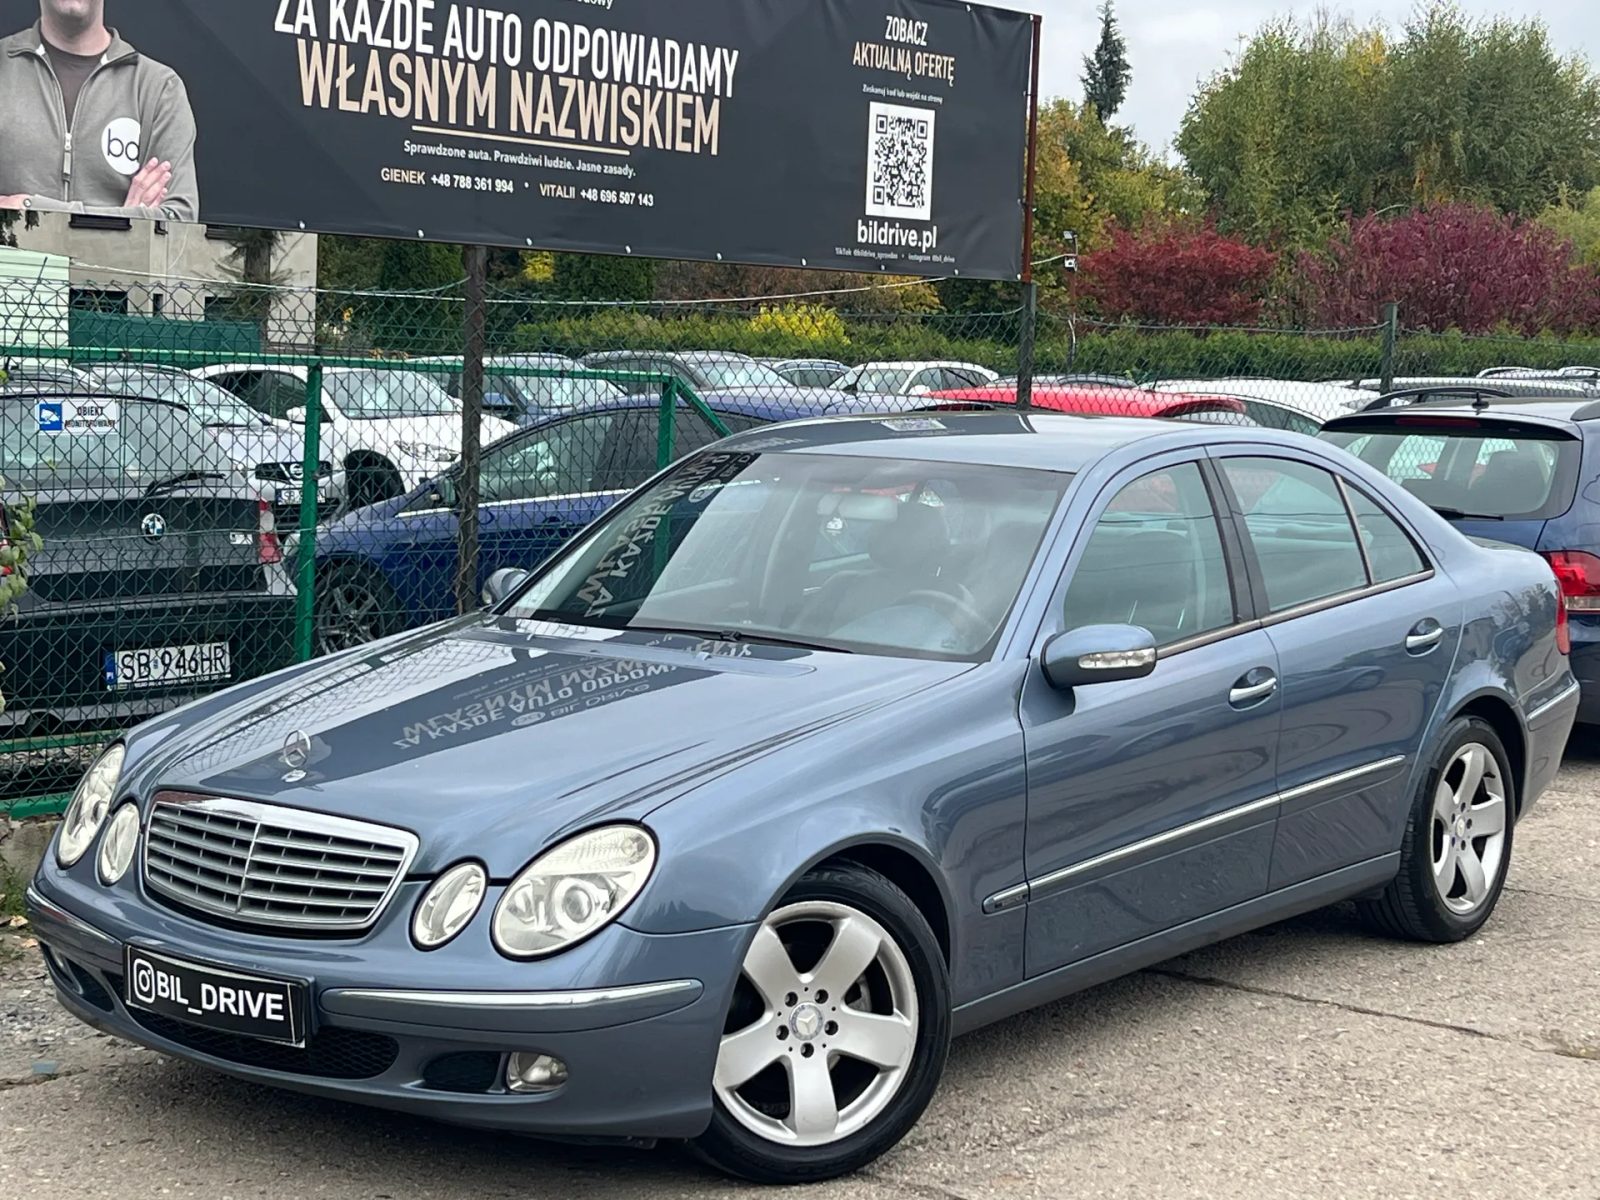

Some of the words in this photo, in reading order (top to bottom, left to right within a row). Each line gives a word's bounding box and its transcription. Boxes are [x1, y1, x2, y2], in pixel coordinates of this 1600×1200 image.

[885, 15, 928, 46] ZOBACZ
[442, 4, 522, 67] AUTO
[532, 18, 739, 98] ODPOWIADAMY
[853, 41, 912, 80] AKTUALNĄ
[914, 51, 955, 87] OFERTĘ
[297, 38, 497, 129] WŁASNYM
[510, 69, 720, 156] NAZWISKIEM
[404, 140, 466, 158] Sprawdzone
[468, 149, 492, 161] auta.
[494, 150, 542, 166] Prawdziwi
[544, 155, 575, 170] ludzie.
[576, 160, 602, 173] Jasne
[603, 164, 636, 179] zasady.
[381, 168, 426, 185] GIENEK
[431, 173, 450, 187] +48
[453, 175, 472, 189] 788
[474, 177, 492, 191] 361
[495, 179, 514, 193] 994
[540, 183, 576, 199] VITALII
[580, 188, 598, 201] +48
[600, 190, 617, 203] 696
[619, 192, 635, 205] 507
[638, 193, 654, 206] 143
[857, 219, 937, 253] bildrive.pl
[121, 653, 151, 680] SB
[161, 645, 226, 678] 946HR
[157, 970, 285, 1021] BIL_DRIVE
